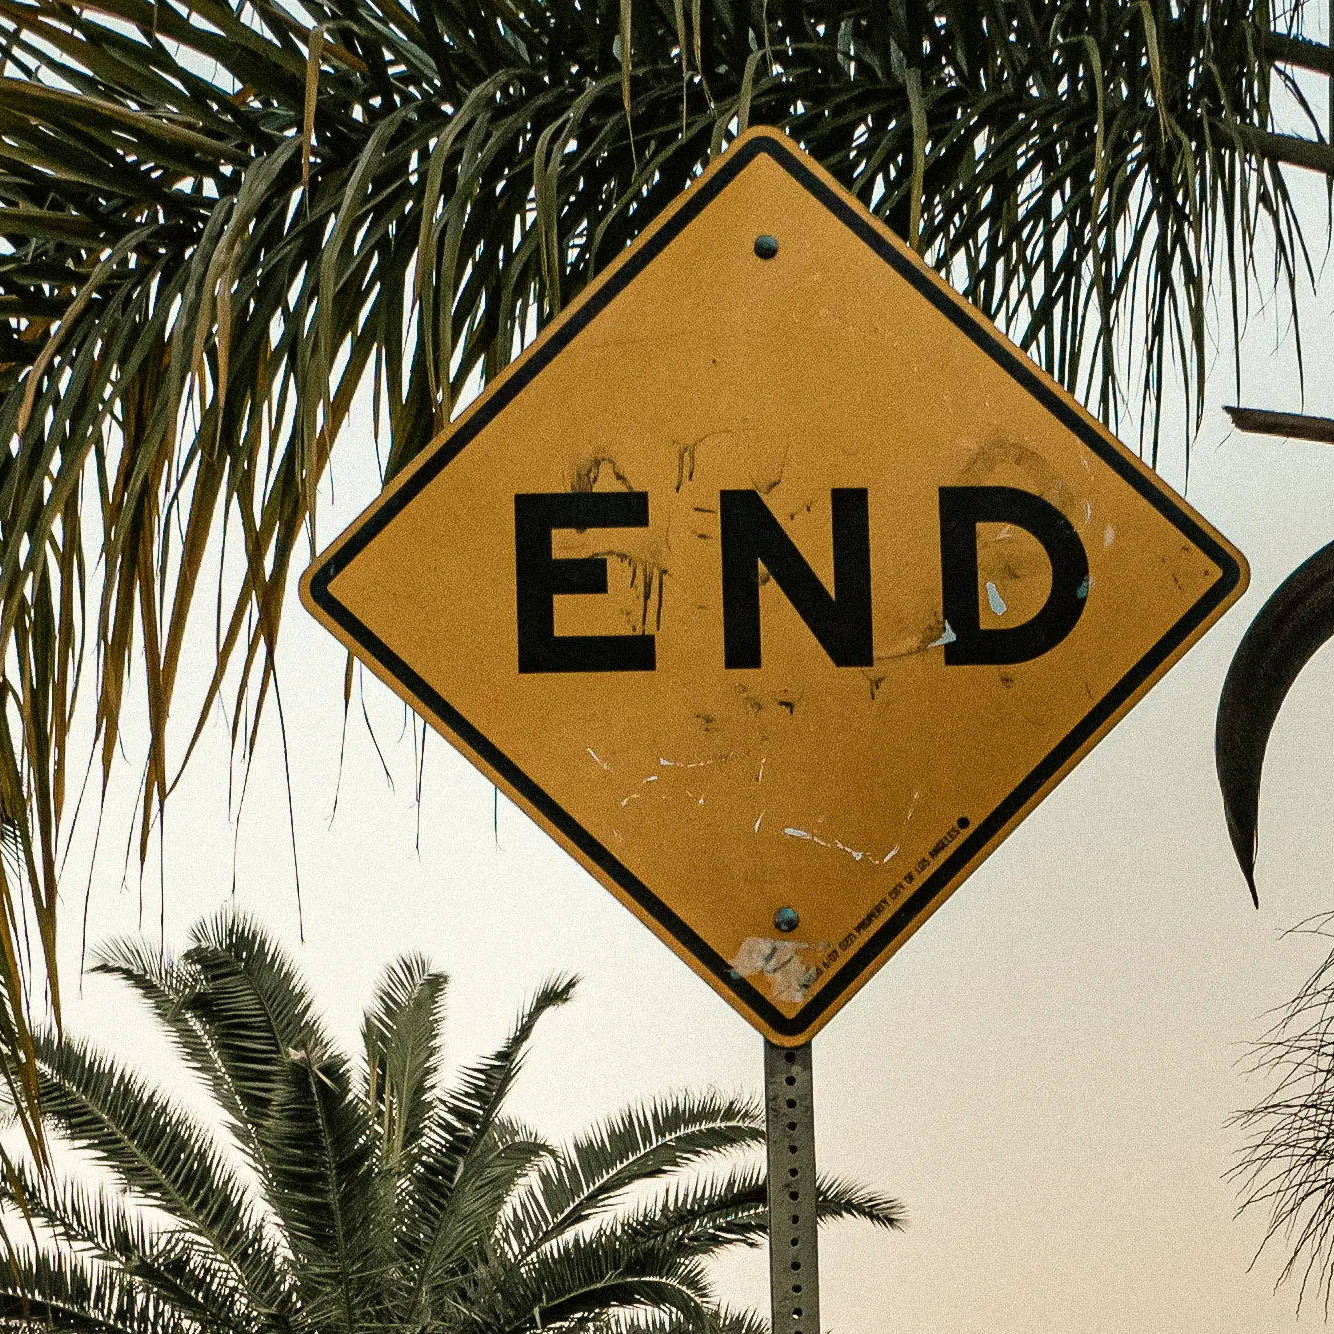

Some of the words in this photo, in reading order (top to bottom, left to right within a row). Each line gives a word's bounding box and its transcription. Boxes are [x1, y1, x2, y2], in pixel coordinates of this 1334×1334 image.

[514, 486, 1089, 674] END
[854, 897, 890, 935] PROPERTY
[887, 882, 906, 901] CITY
[903, 872, 915, 885] OF
[914, 857, 931, 875] LOS
[928, 826, 961, 860] ANGELES
